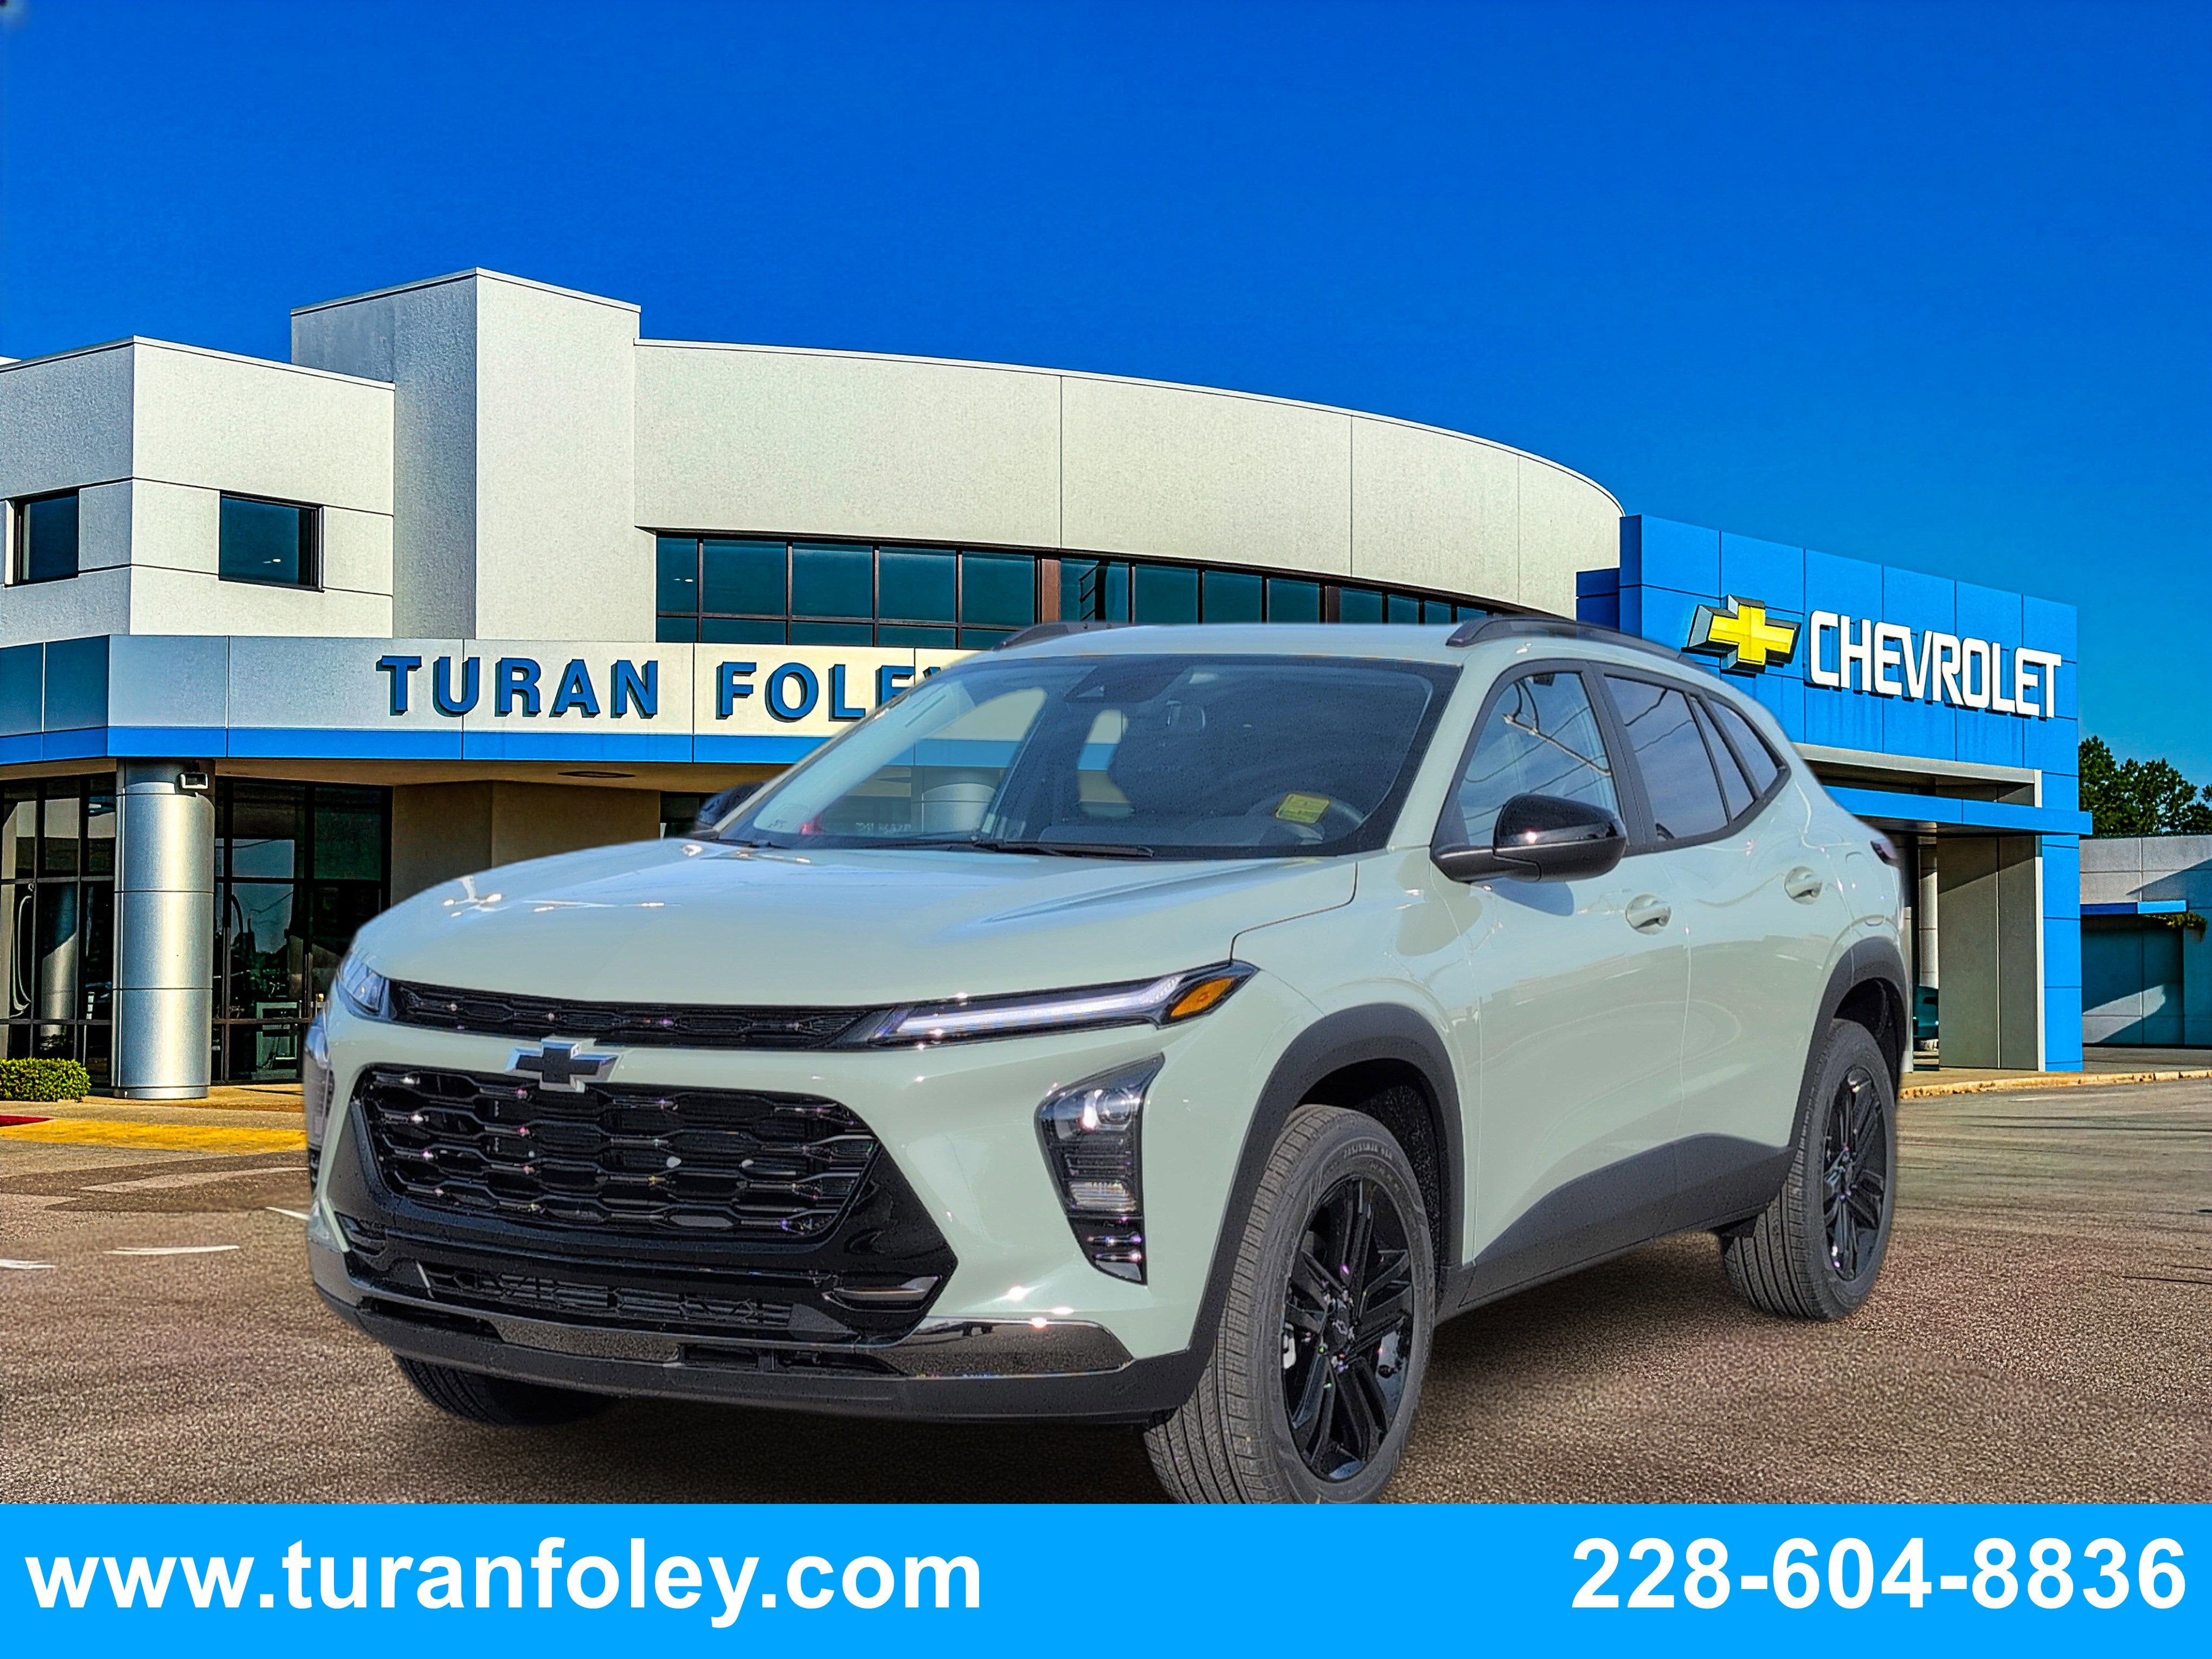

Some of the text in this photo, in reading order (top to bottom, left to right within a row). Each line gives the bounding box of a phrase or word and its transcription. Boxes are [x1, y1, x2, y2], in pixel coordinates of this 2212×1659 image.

[376, 655, 941, 723] TURAN FOLE
[1810, 610, 2062, 719] CHEVROLET
